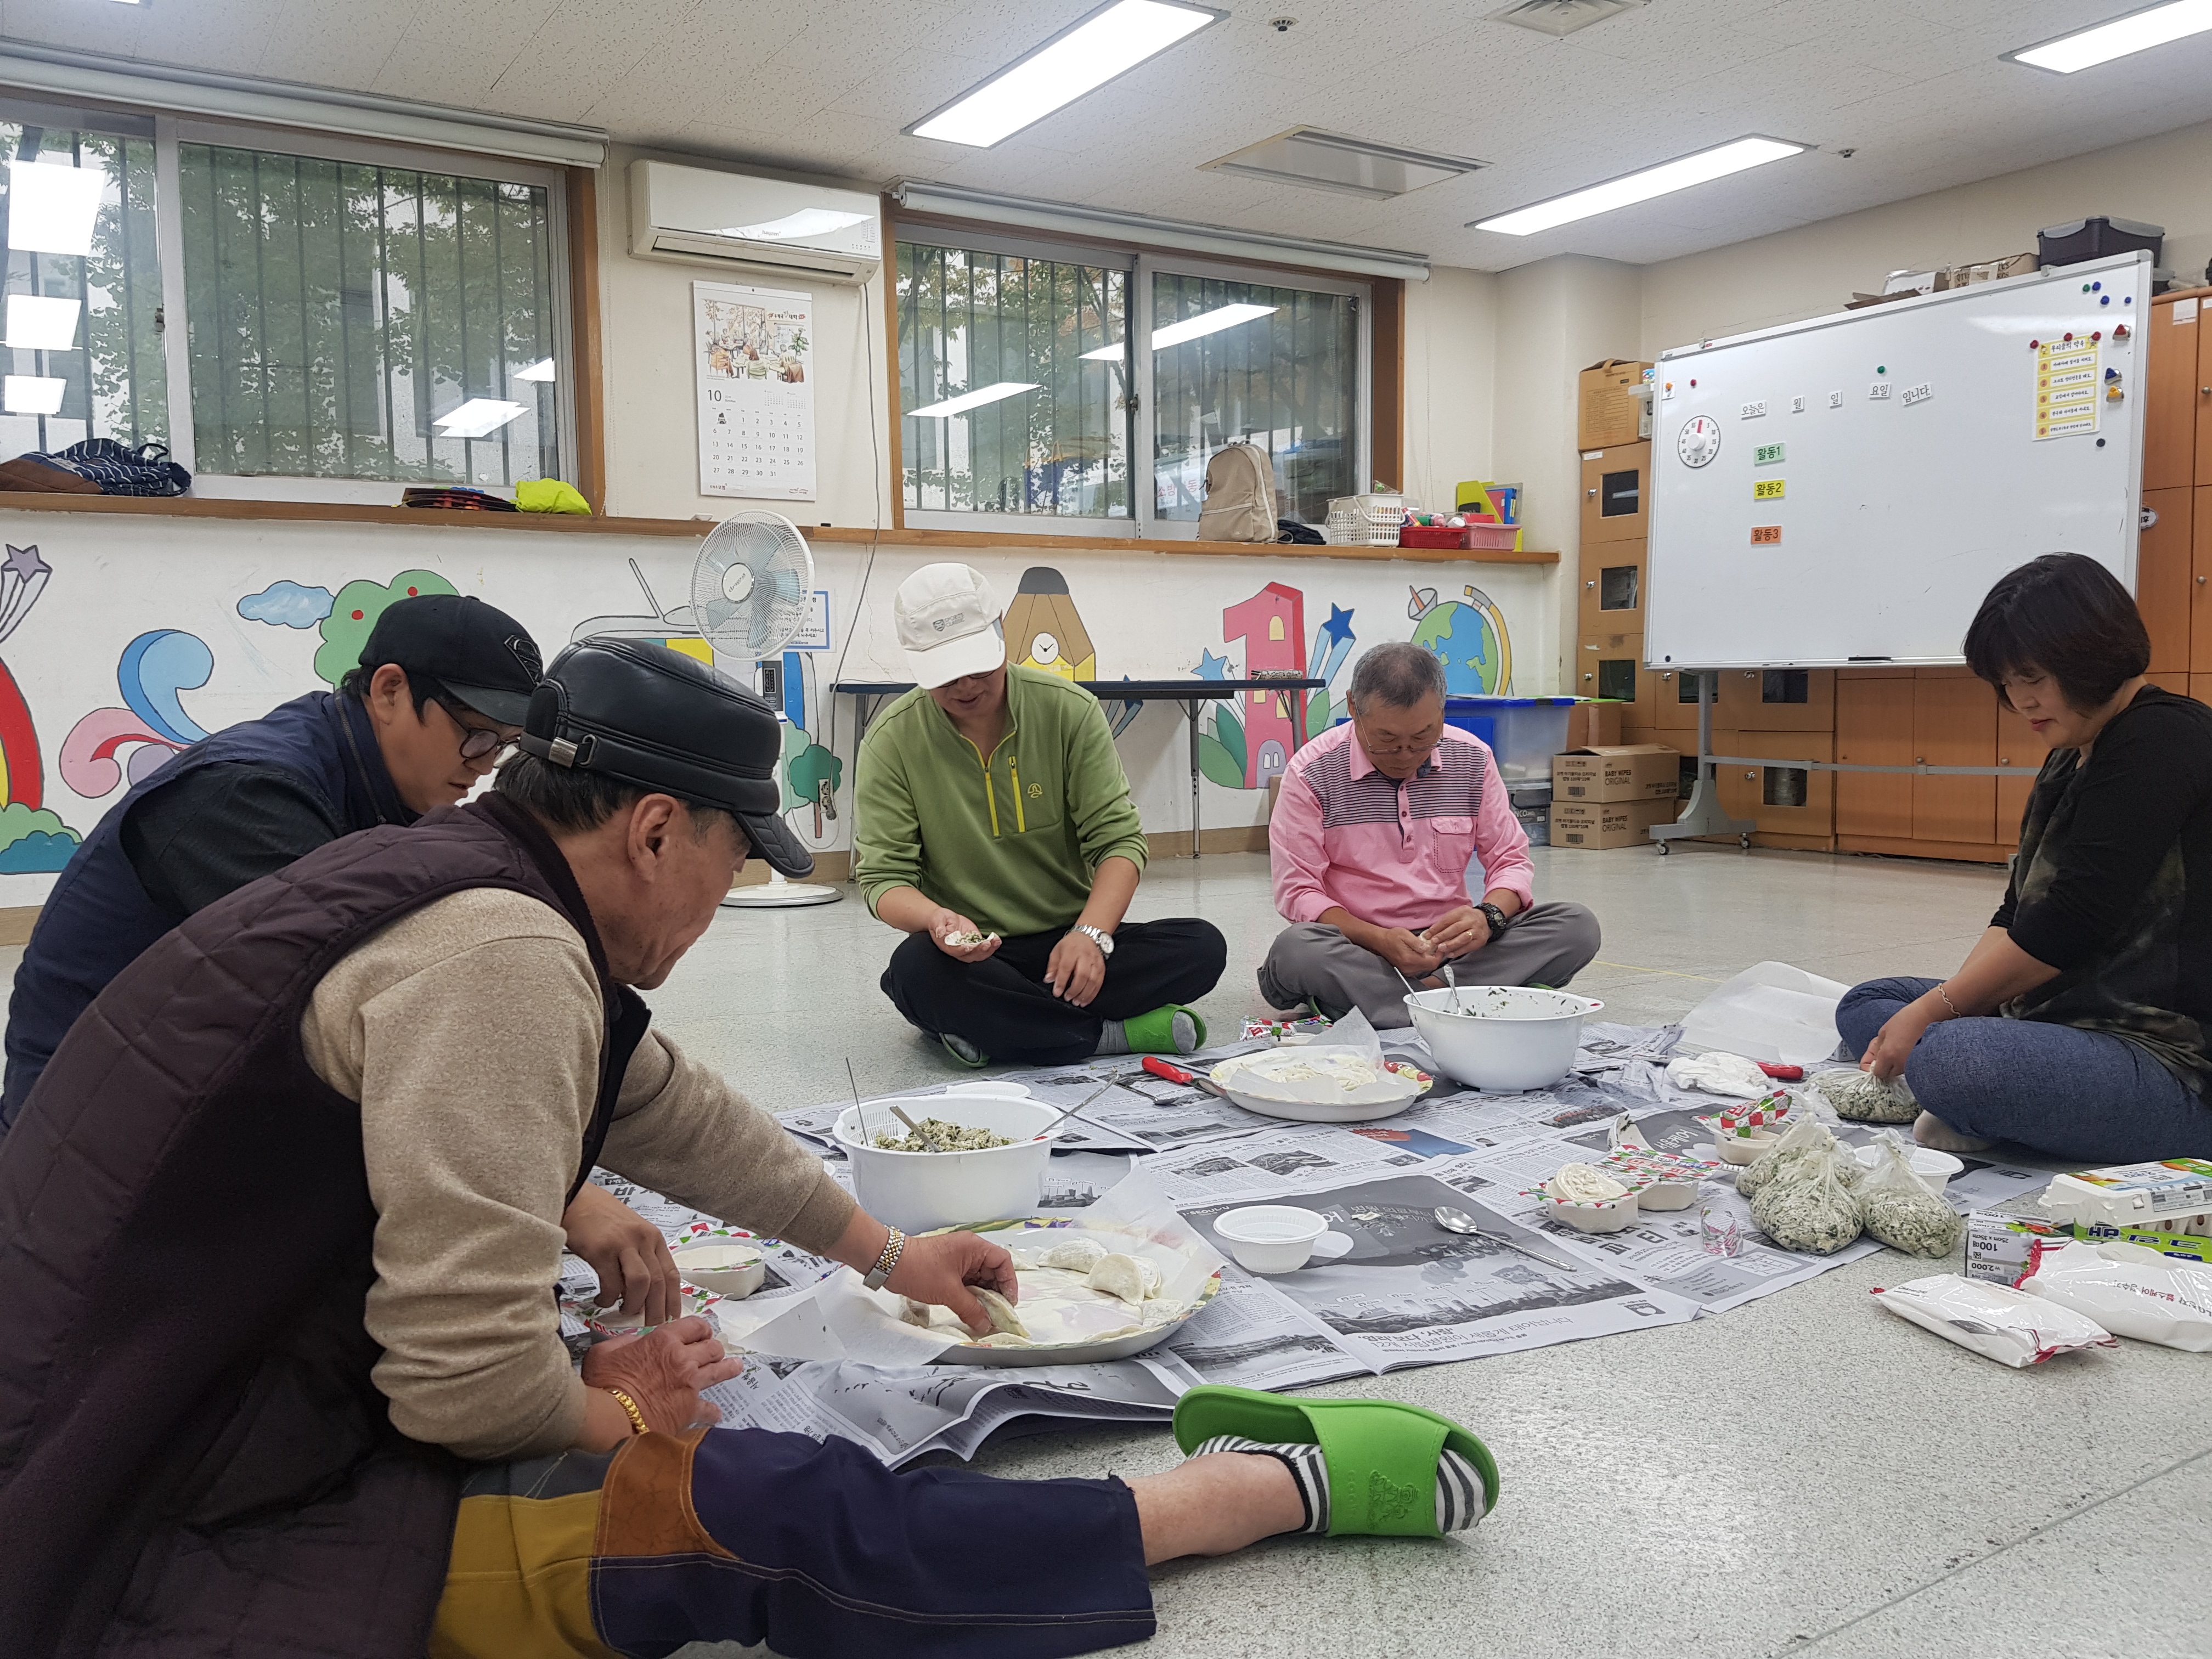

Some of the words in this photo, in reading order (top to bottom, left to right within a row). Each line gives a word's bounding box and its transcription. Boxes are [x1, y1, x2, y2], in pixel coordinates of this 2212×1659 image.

[2051, 342, 2072, 353] 우리들의
[2074, 340, 2084, 348] 약속
[708, 390, 721, 402] 10
[1741, 403, 1765, 416] 오늘은
[1793, 398, 1802, 409] 월
[1831, 393, 1839, 405] 일
[1870, 384, 1889, 396] 요일
[1903, 385, 1931, 403] 입니다.
[1758, 445, 1780, 461] 활동1
[1757, 483, 1781, 496] 활동2
[1753, 529, 1779, 541] 활동3
[1605, 777, 1630, 786] ORIGINAL
[1602, 823, 1627, 832] ORIGINAL
[1972, 1240, 1998, 1251] 100매
[2142, 1286, 2175, 1301] 헬스케어
[1403, 1334, 1466, 1348] 시립병원이
[1469, 1327, 1510, 1339] 새롭게
[1509, 1317, 1574, 1331] 태어납니다
